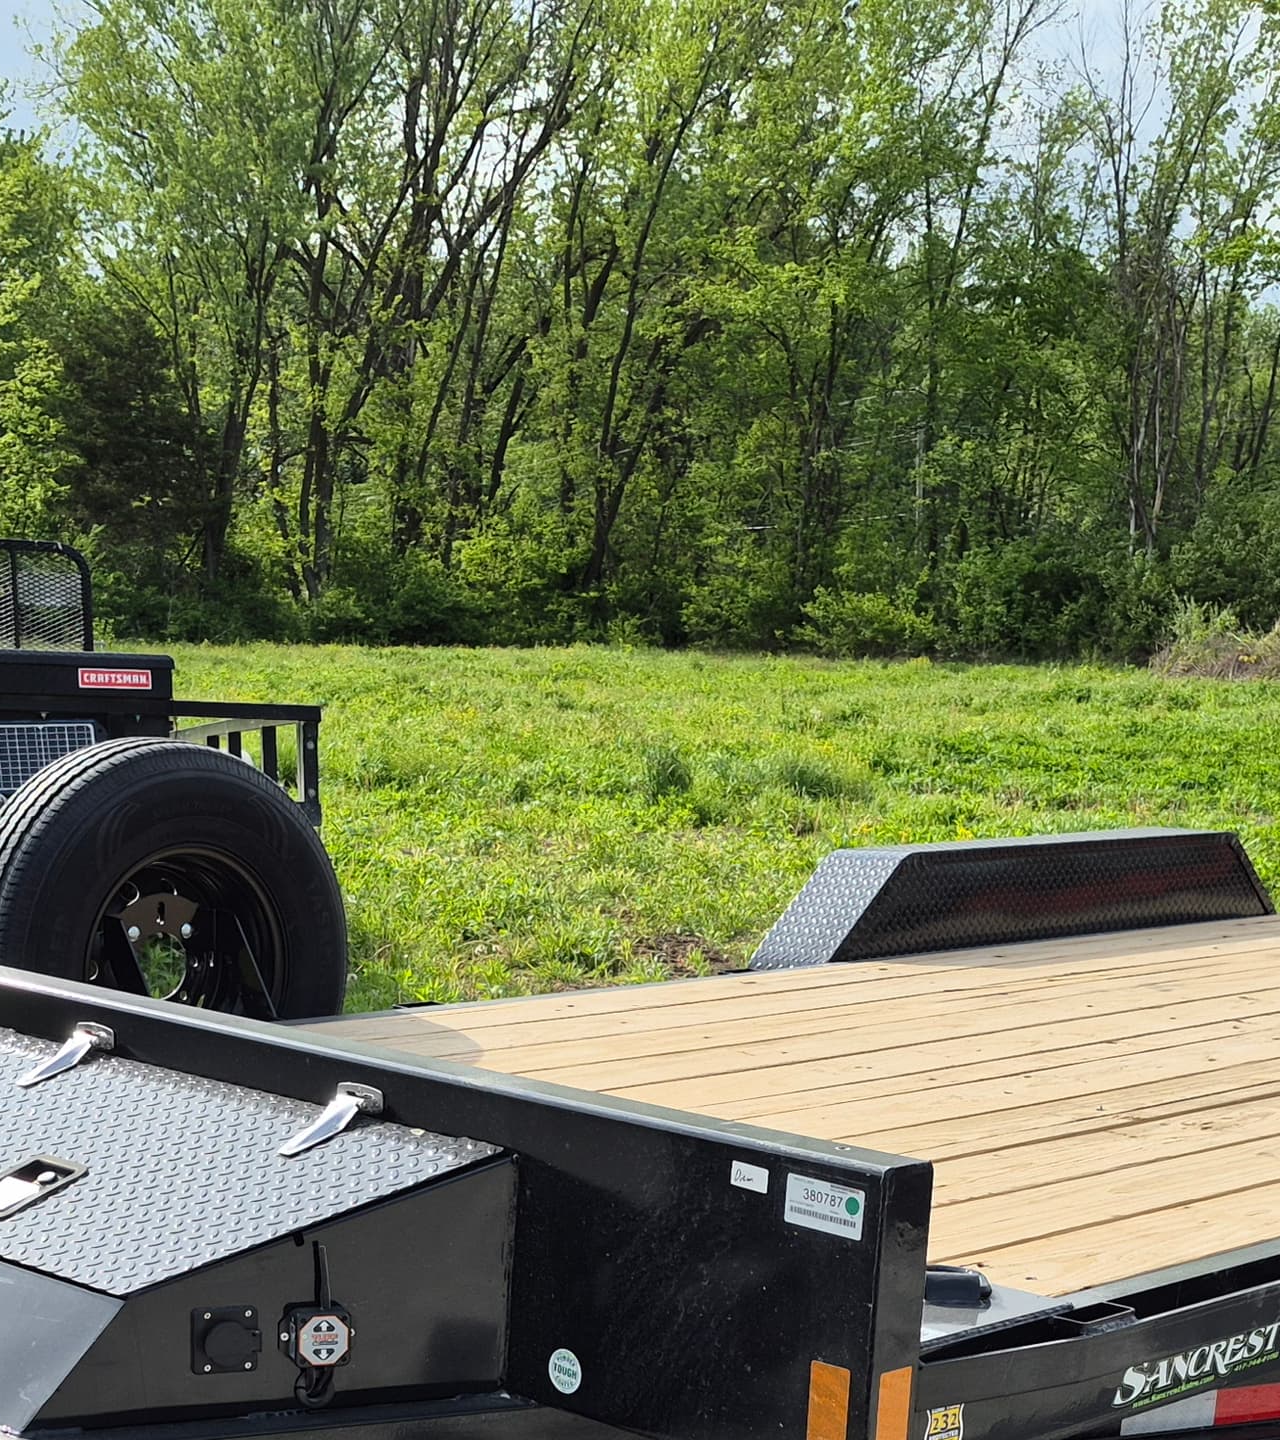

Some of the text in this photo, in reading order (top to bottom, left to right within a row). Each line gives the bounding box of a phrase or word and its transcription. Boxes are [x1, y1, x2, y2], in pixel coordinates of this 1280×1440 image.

[82, 672, 149, 685] CRAFTSMAN
[803, 1187, 844, 1208] 380787
[553, 1363, 577, 1380] TOUGH
